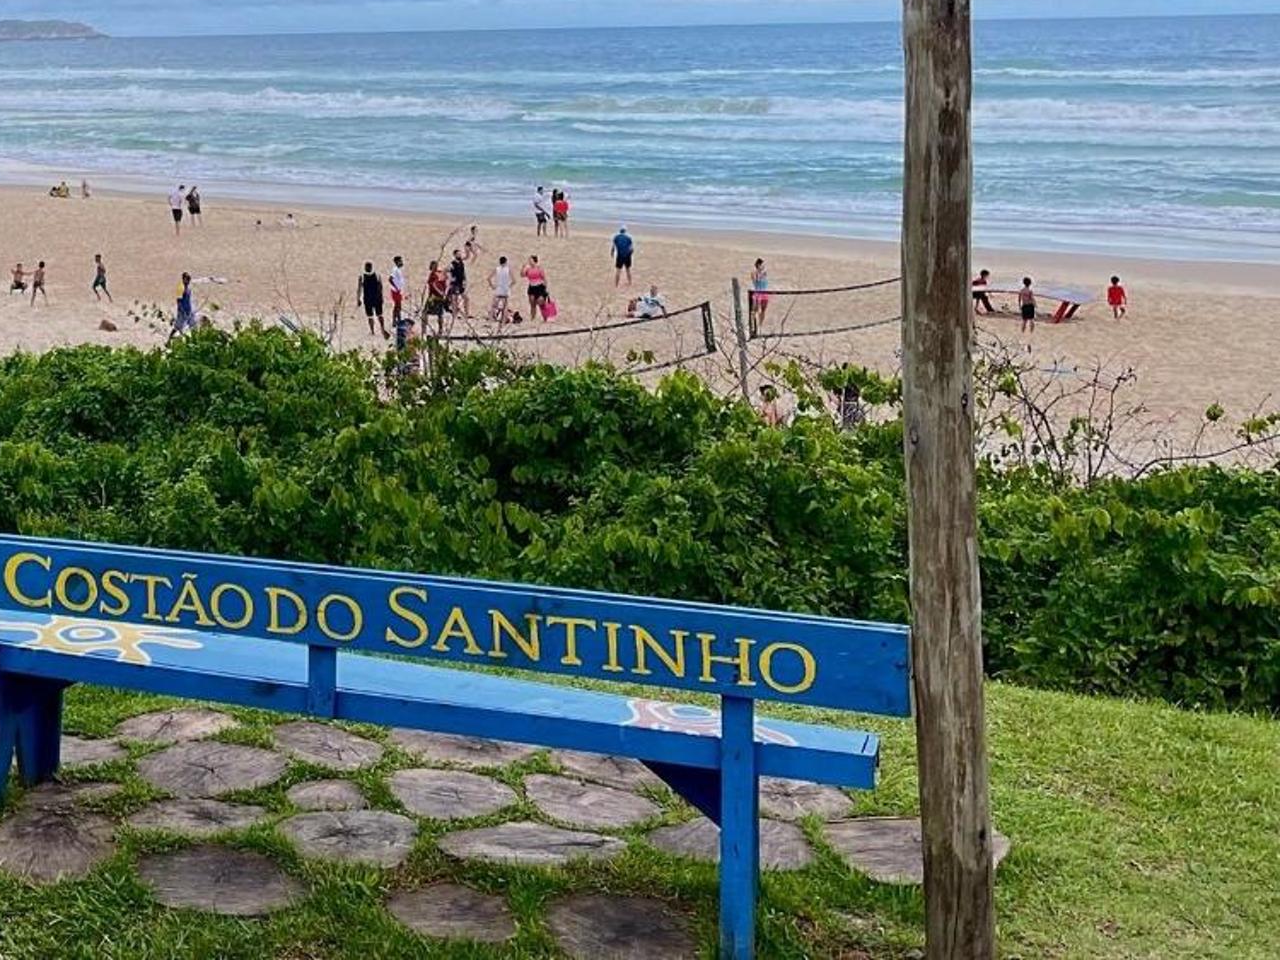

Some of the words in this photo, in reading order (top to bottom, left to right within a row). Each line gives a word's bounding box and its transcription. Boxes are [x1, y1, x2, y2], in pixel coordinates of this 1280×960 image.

[3, 551, 256, 632] COSTÃO
[264, 584, 364, 642] DO
[385, 585, 817, 695] SANTINHO
